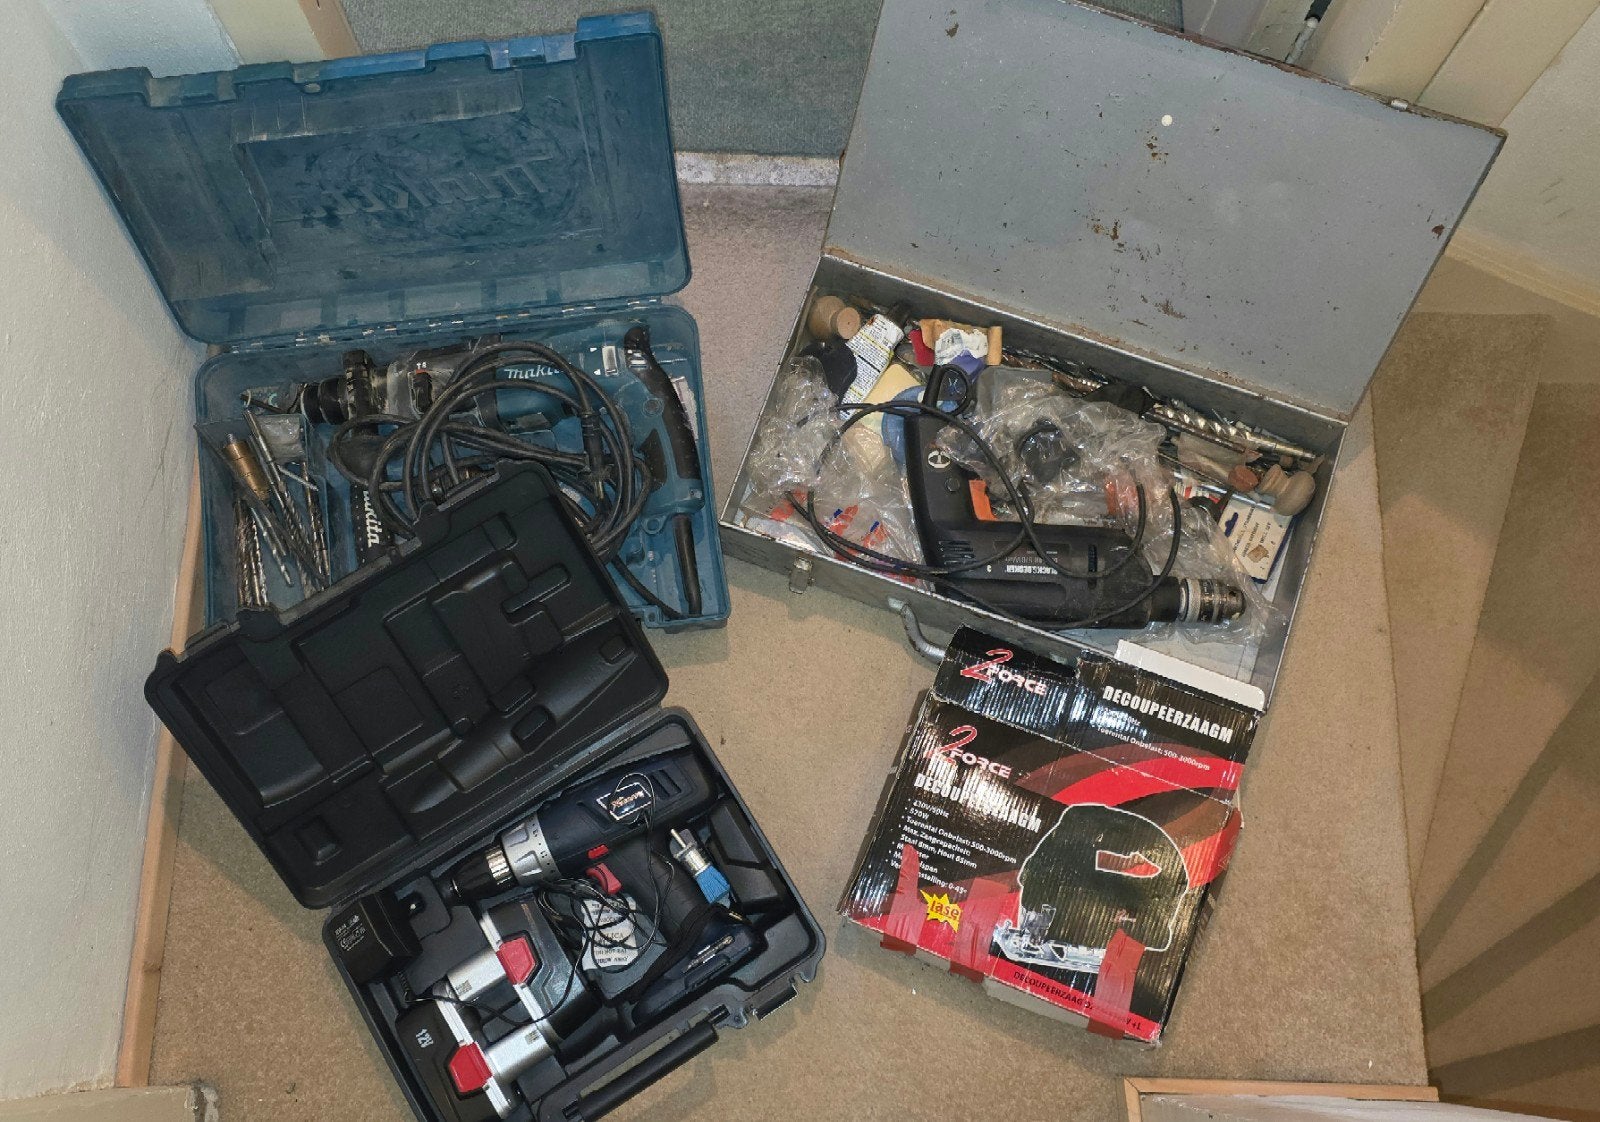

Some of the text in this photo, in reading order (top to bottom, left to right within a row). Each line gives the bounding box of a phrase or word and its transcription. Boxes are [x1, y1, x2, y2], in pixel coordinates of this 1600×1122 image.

[504, 364, 564, 379] maki
[986, 662, 1048, 696] FORCE
[1101, 684, 1234, 744] DECOUPEERZAAGM
[948, 747, 1012, 779] FORCE
[930, 900, 960, 921] lase
